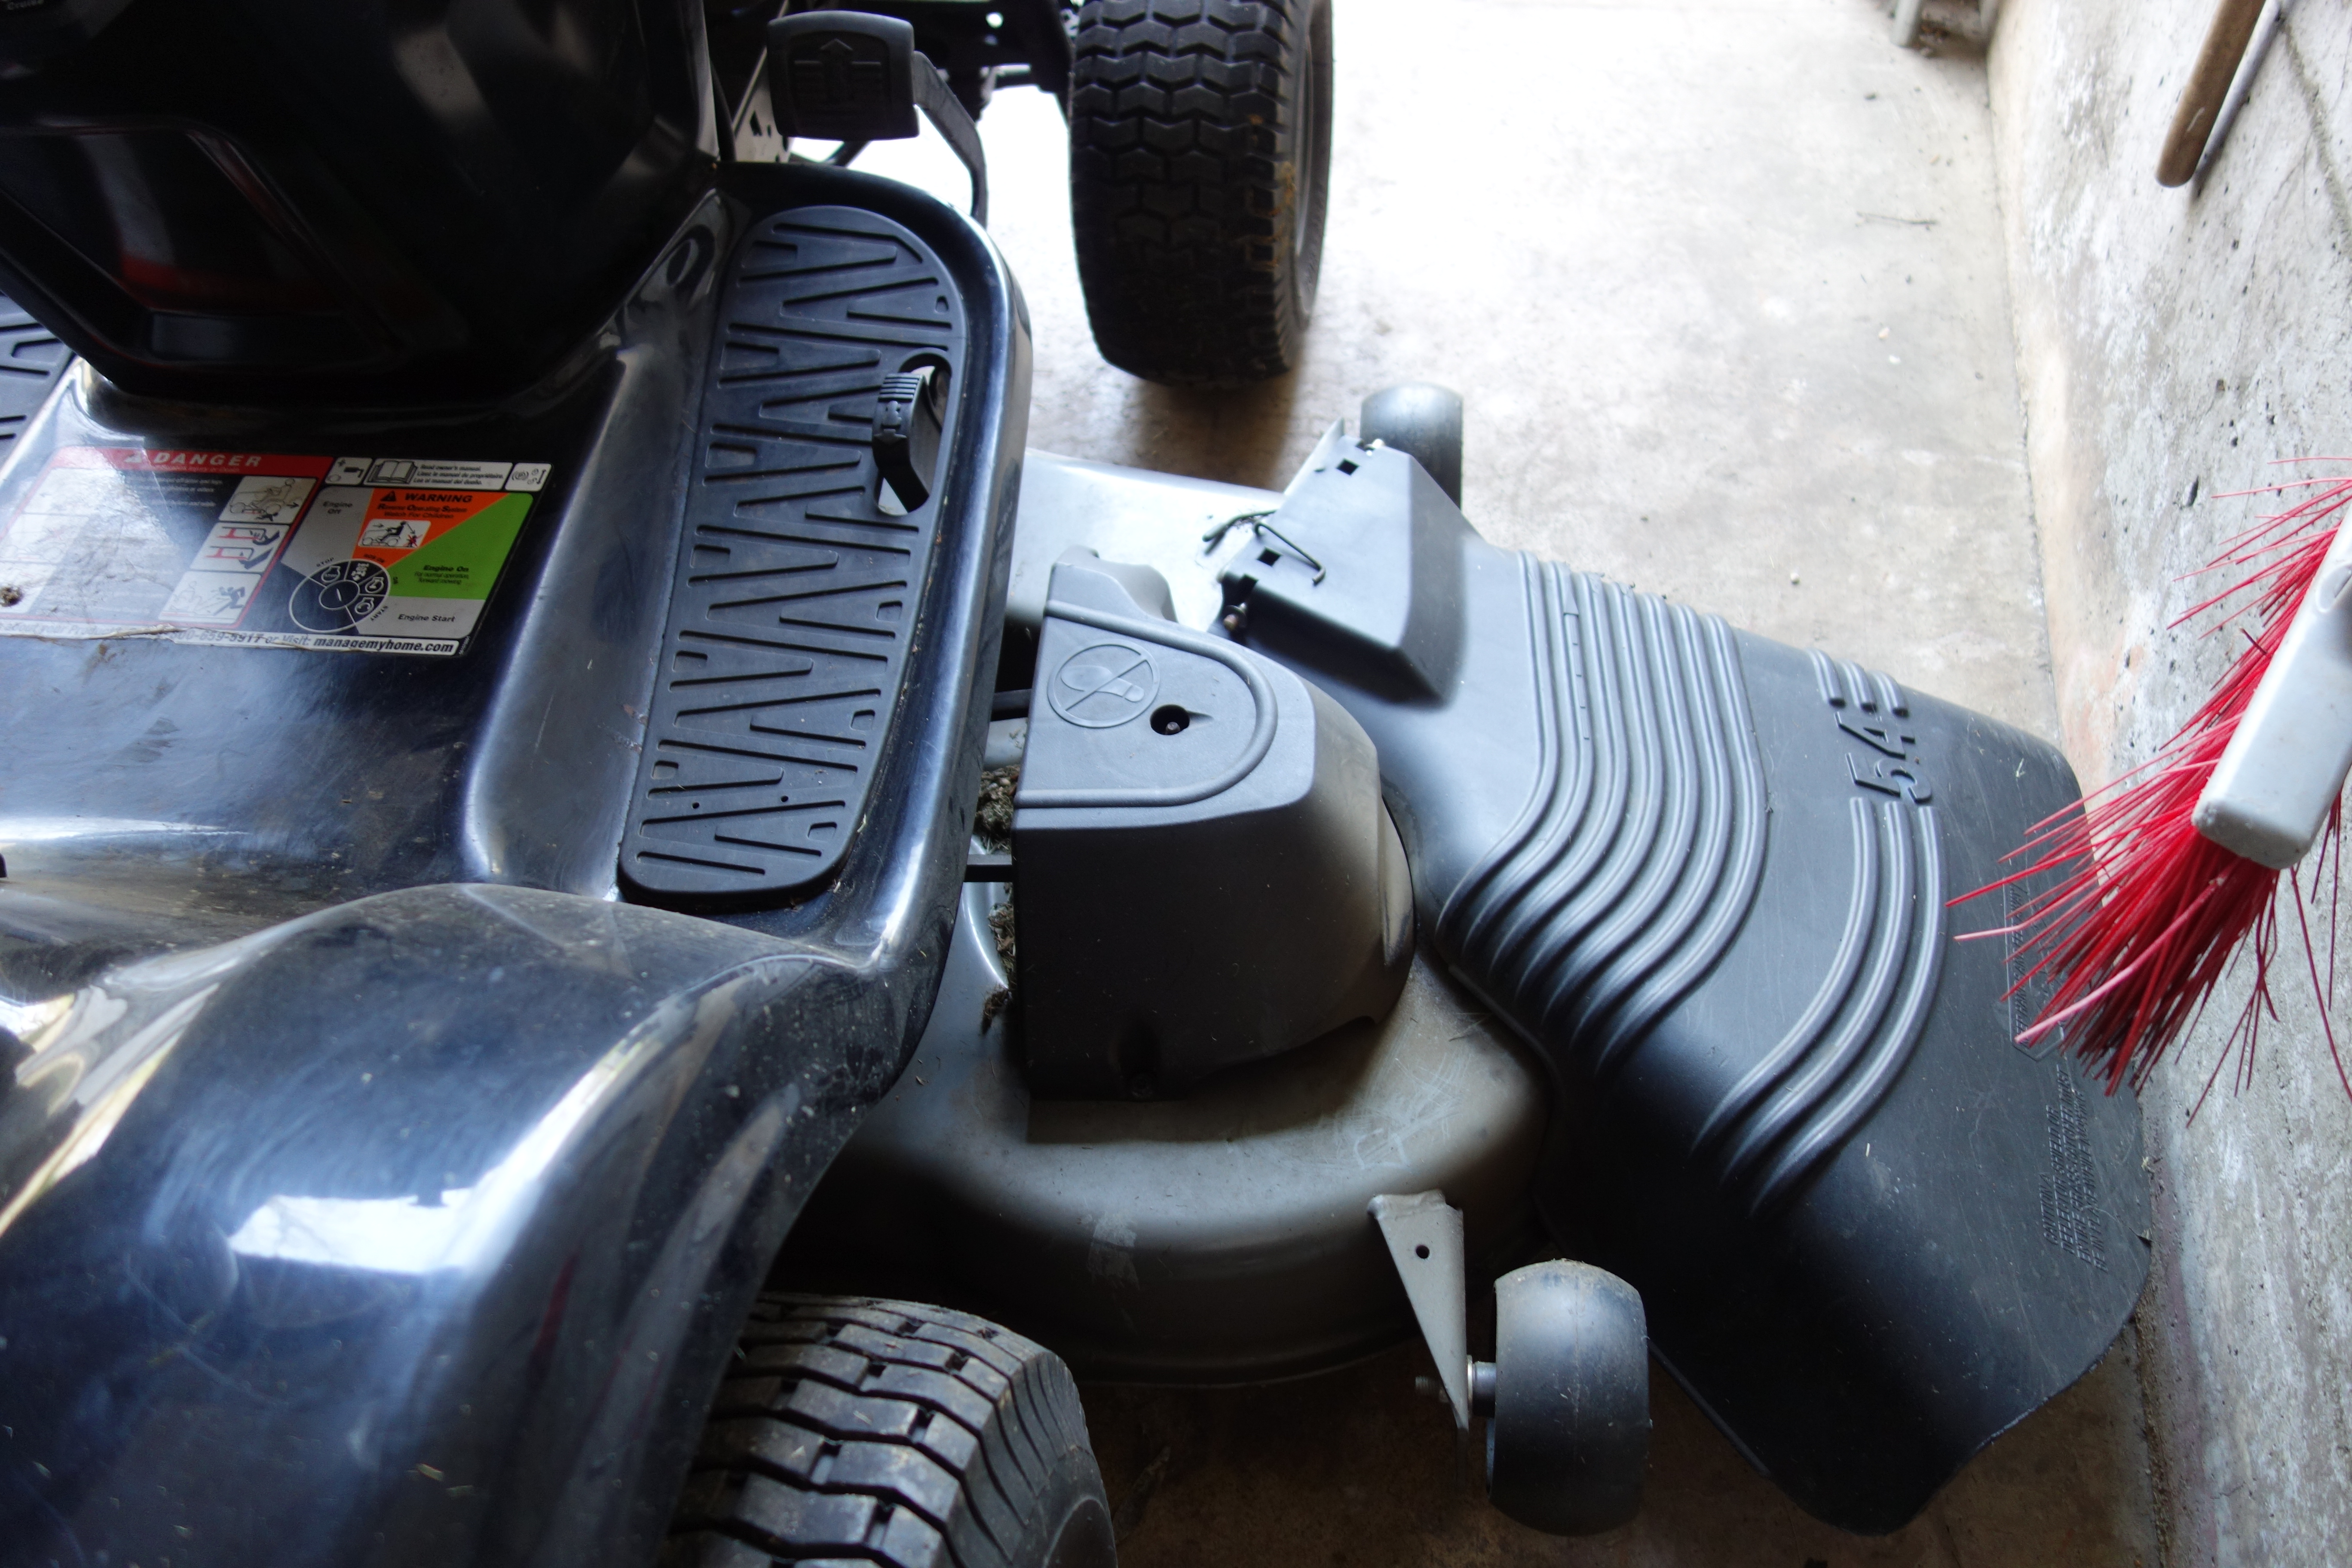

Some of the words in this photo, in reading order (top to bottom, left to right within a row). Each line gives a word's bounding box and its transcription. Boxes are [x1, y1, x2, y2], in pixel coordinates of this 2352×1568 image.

[153, 452, 262, 467] DANGER
[405, 493, 473, 502] WARNING
[316, 557, 334, 567] STOP
[370, 605, 389, 622] START
[398, 613, 429, 622] Engine
[314, 637, 454, 653] managemyhome.com
[1833, 710, 1934, 805] 54
[2046, 1104, 2060, 1127] OR
[2048, 1126, 2064, 1173] SHIELD
[2060, 1104, 2078, 1165] CATCHER
[2078, 1142, 2095, 1188] WHILE
[2066, 1163, 2083, 1211] GRASS
[2039, 1183, 2059, 1245] CAUTION
[2052, 1174, 2075, 1255] DEFLECTOR
[2083, 1186, 2102, 1234] PLACE
[2072, 1211, 2092, 1264] ENTIRE
[2089, 1232, 2105, 1253] IN
[2092, 1250, 2108, 1274] BE
